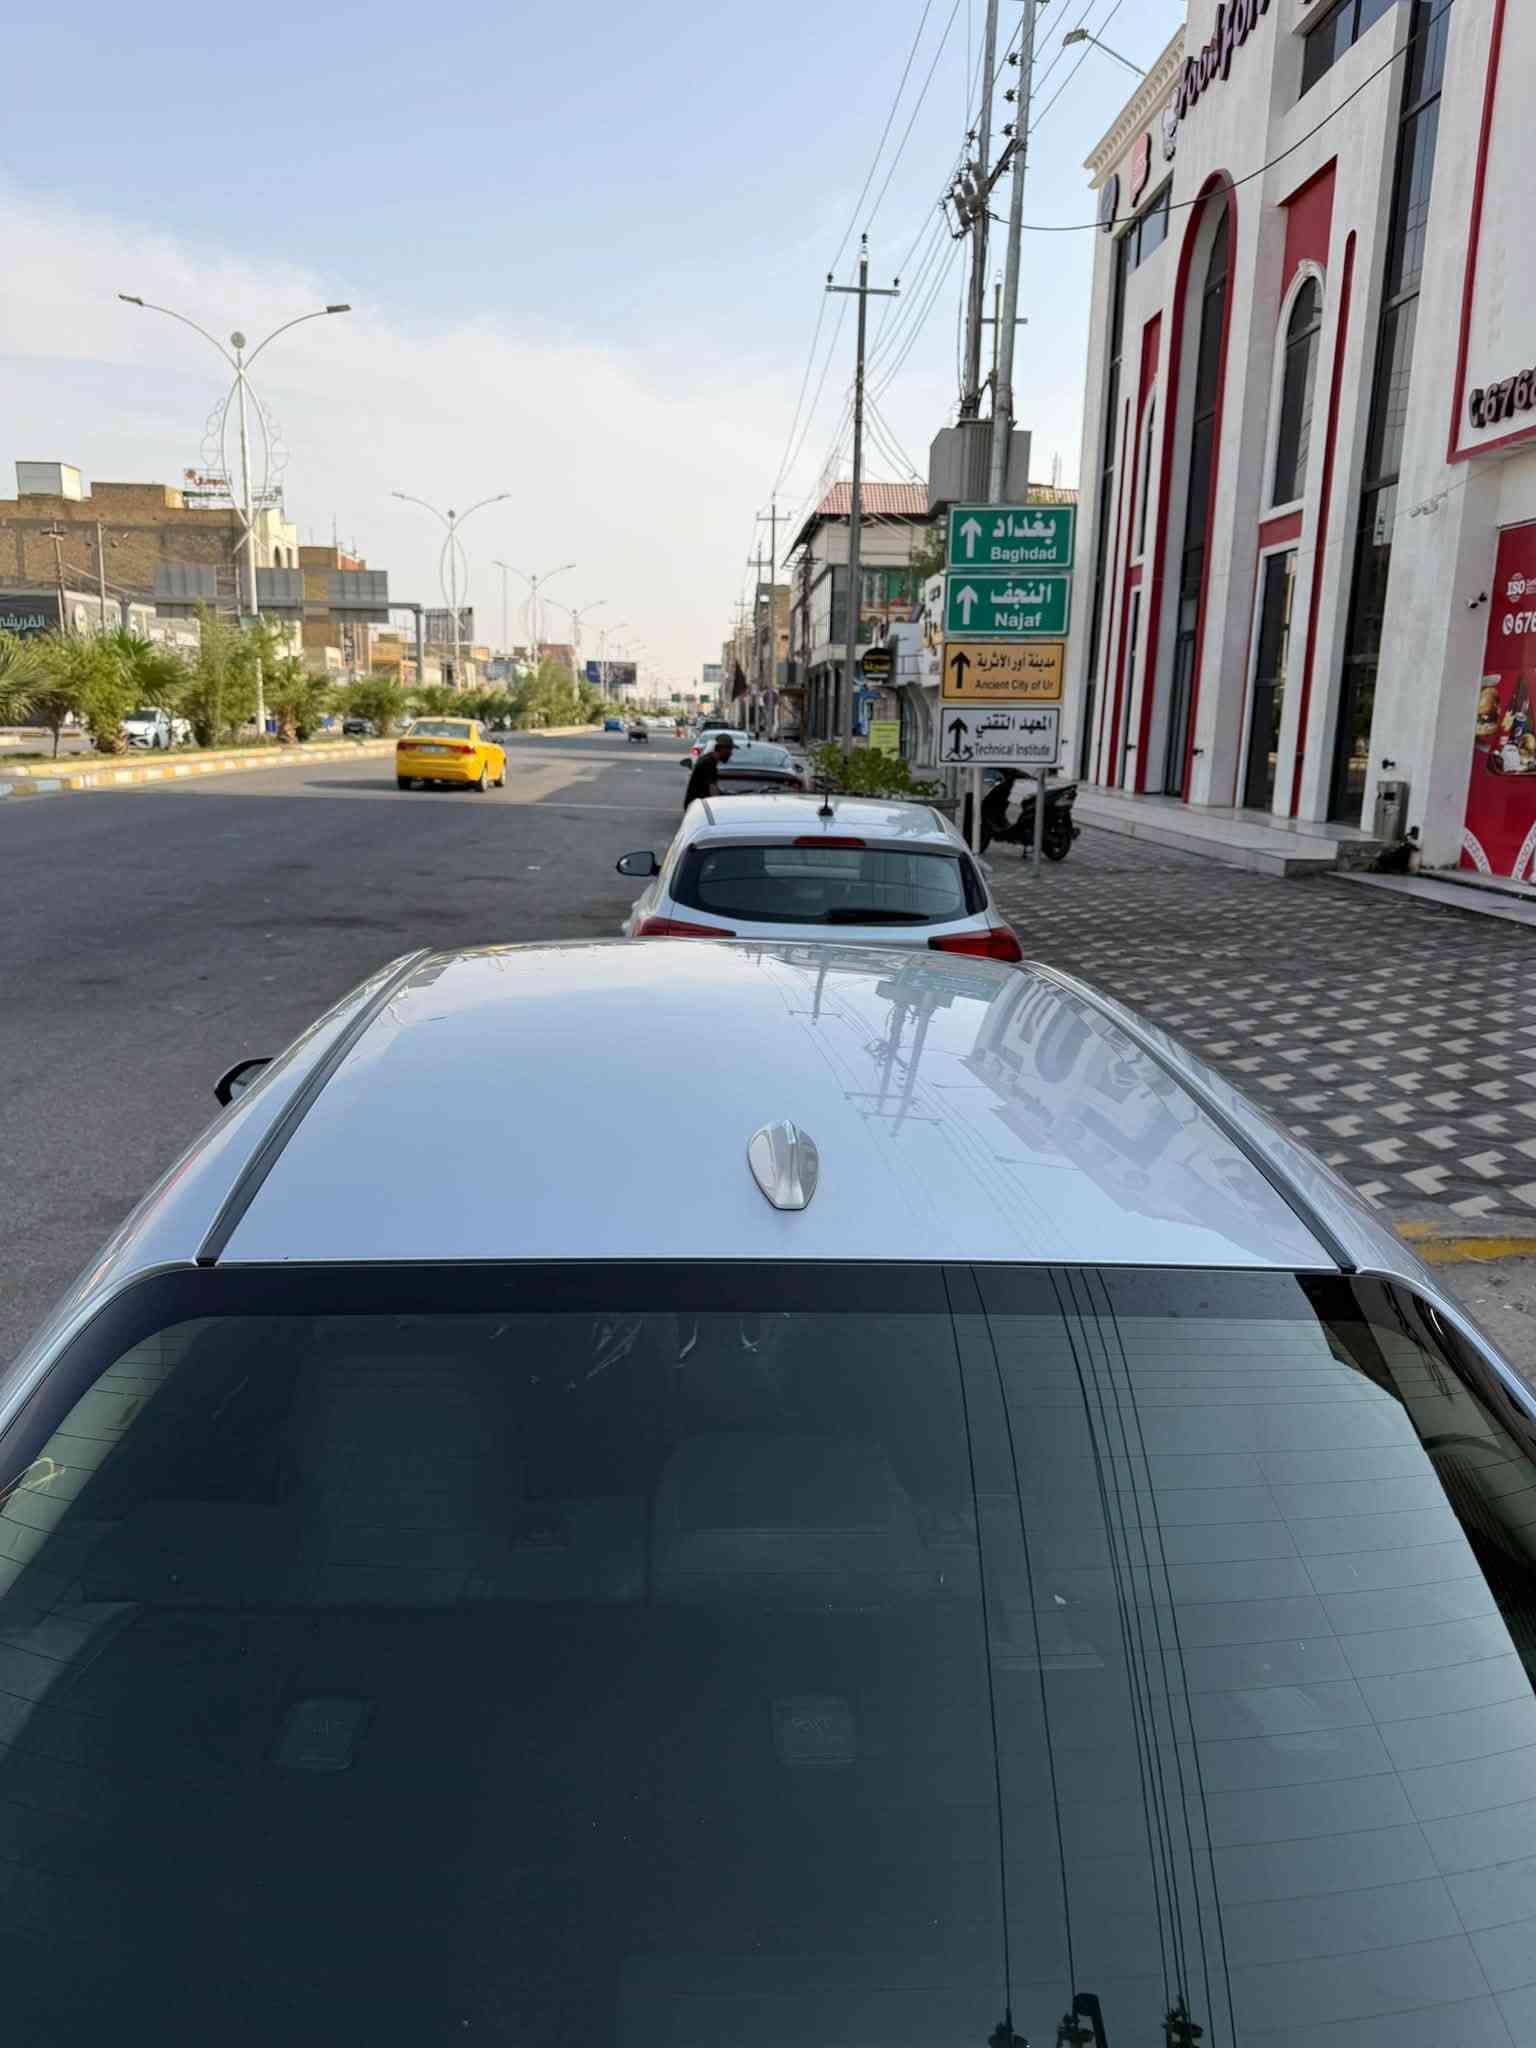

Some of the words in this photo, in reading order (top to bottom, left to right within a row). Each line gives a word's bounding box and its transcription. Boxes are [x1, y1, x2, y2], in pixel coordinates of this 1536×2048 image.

[991, 511, 1057, 545] بغداد
[990, 546, 1057, 563] Baghdad
[989, 581, 1052, 610] النجف
[994, 611, 1043, 631] Najaf
[1027, 653, 1055, 673] مدينة
[975, 679, 1009, 690] Ancient
[1011, 679, 1029, 692] City
[1031, 679, 1041, 690] of
[1042, 679, 1054, 691] Ur
[975, 713, 1016, 739] التقني
[1019, 714, 1053, 735] المعهد
[974, 742, 1013, 756] Technical
[1015, 742, 1050, 756] Institute
